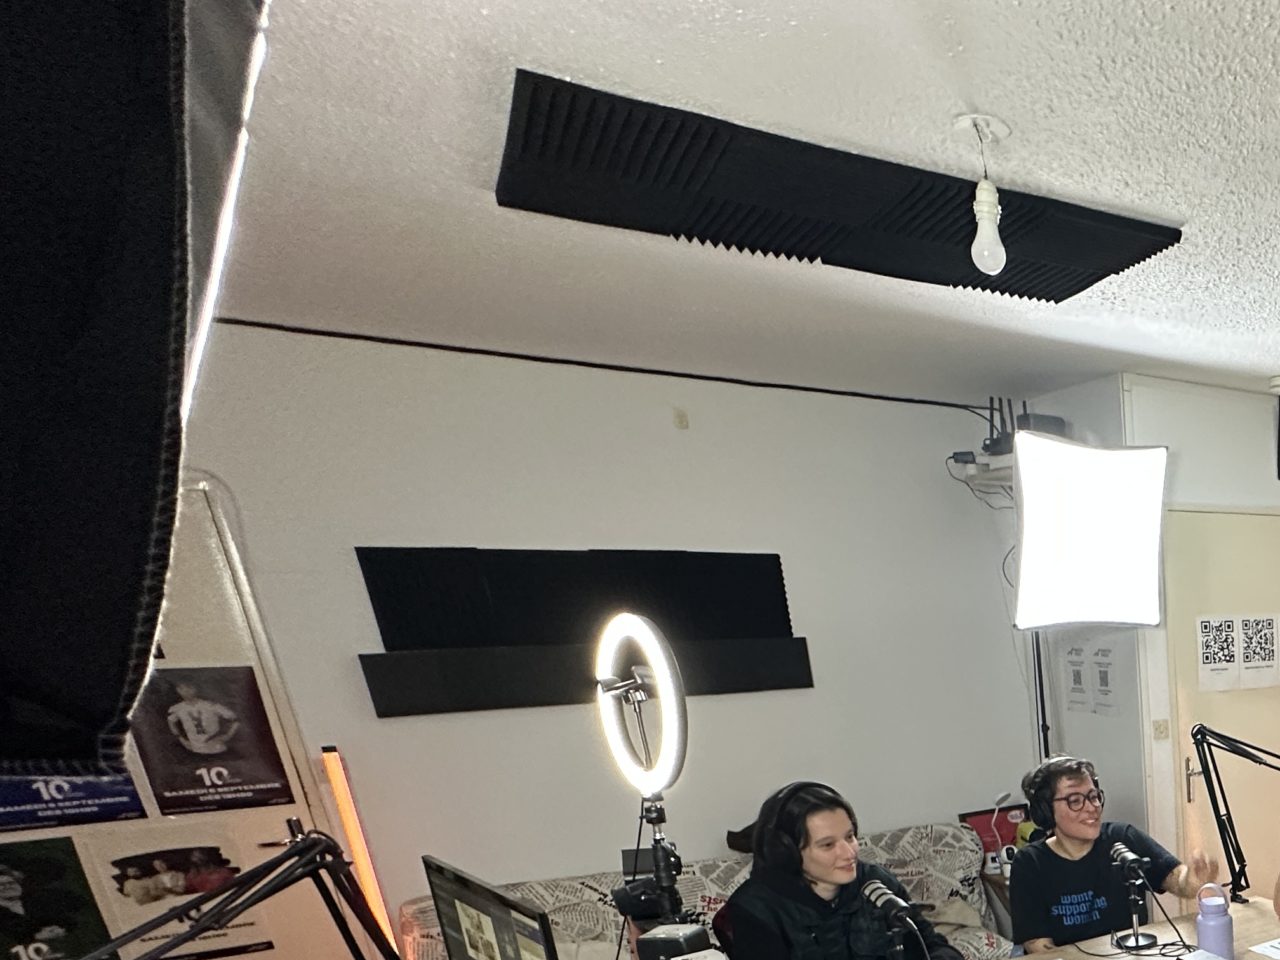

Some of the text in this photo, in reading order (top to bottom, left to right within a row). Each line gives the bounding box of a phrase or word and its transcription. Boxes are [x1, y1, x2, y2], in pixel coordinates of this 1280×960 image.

[195, 766, 229, 786] 10
[31, 780, 72, 800] 10
[1063, 910, 1100, 925] womn
